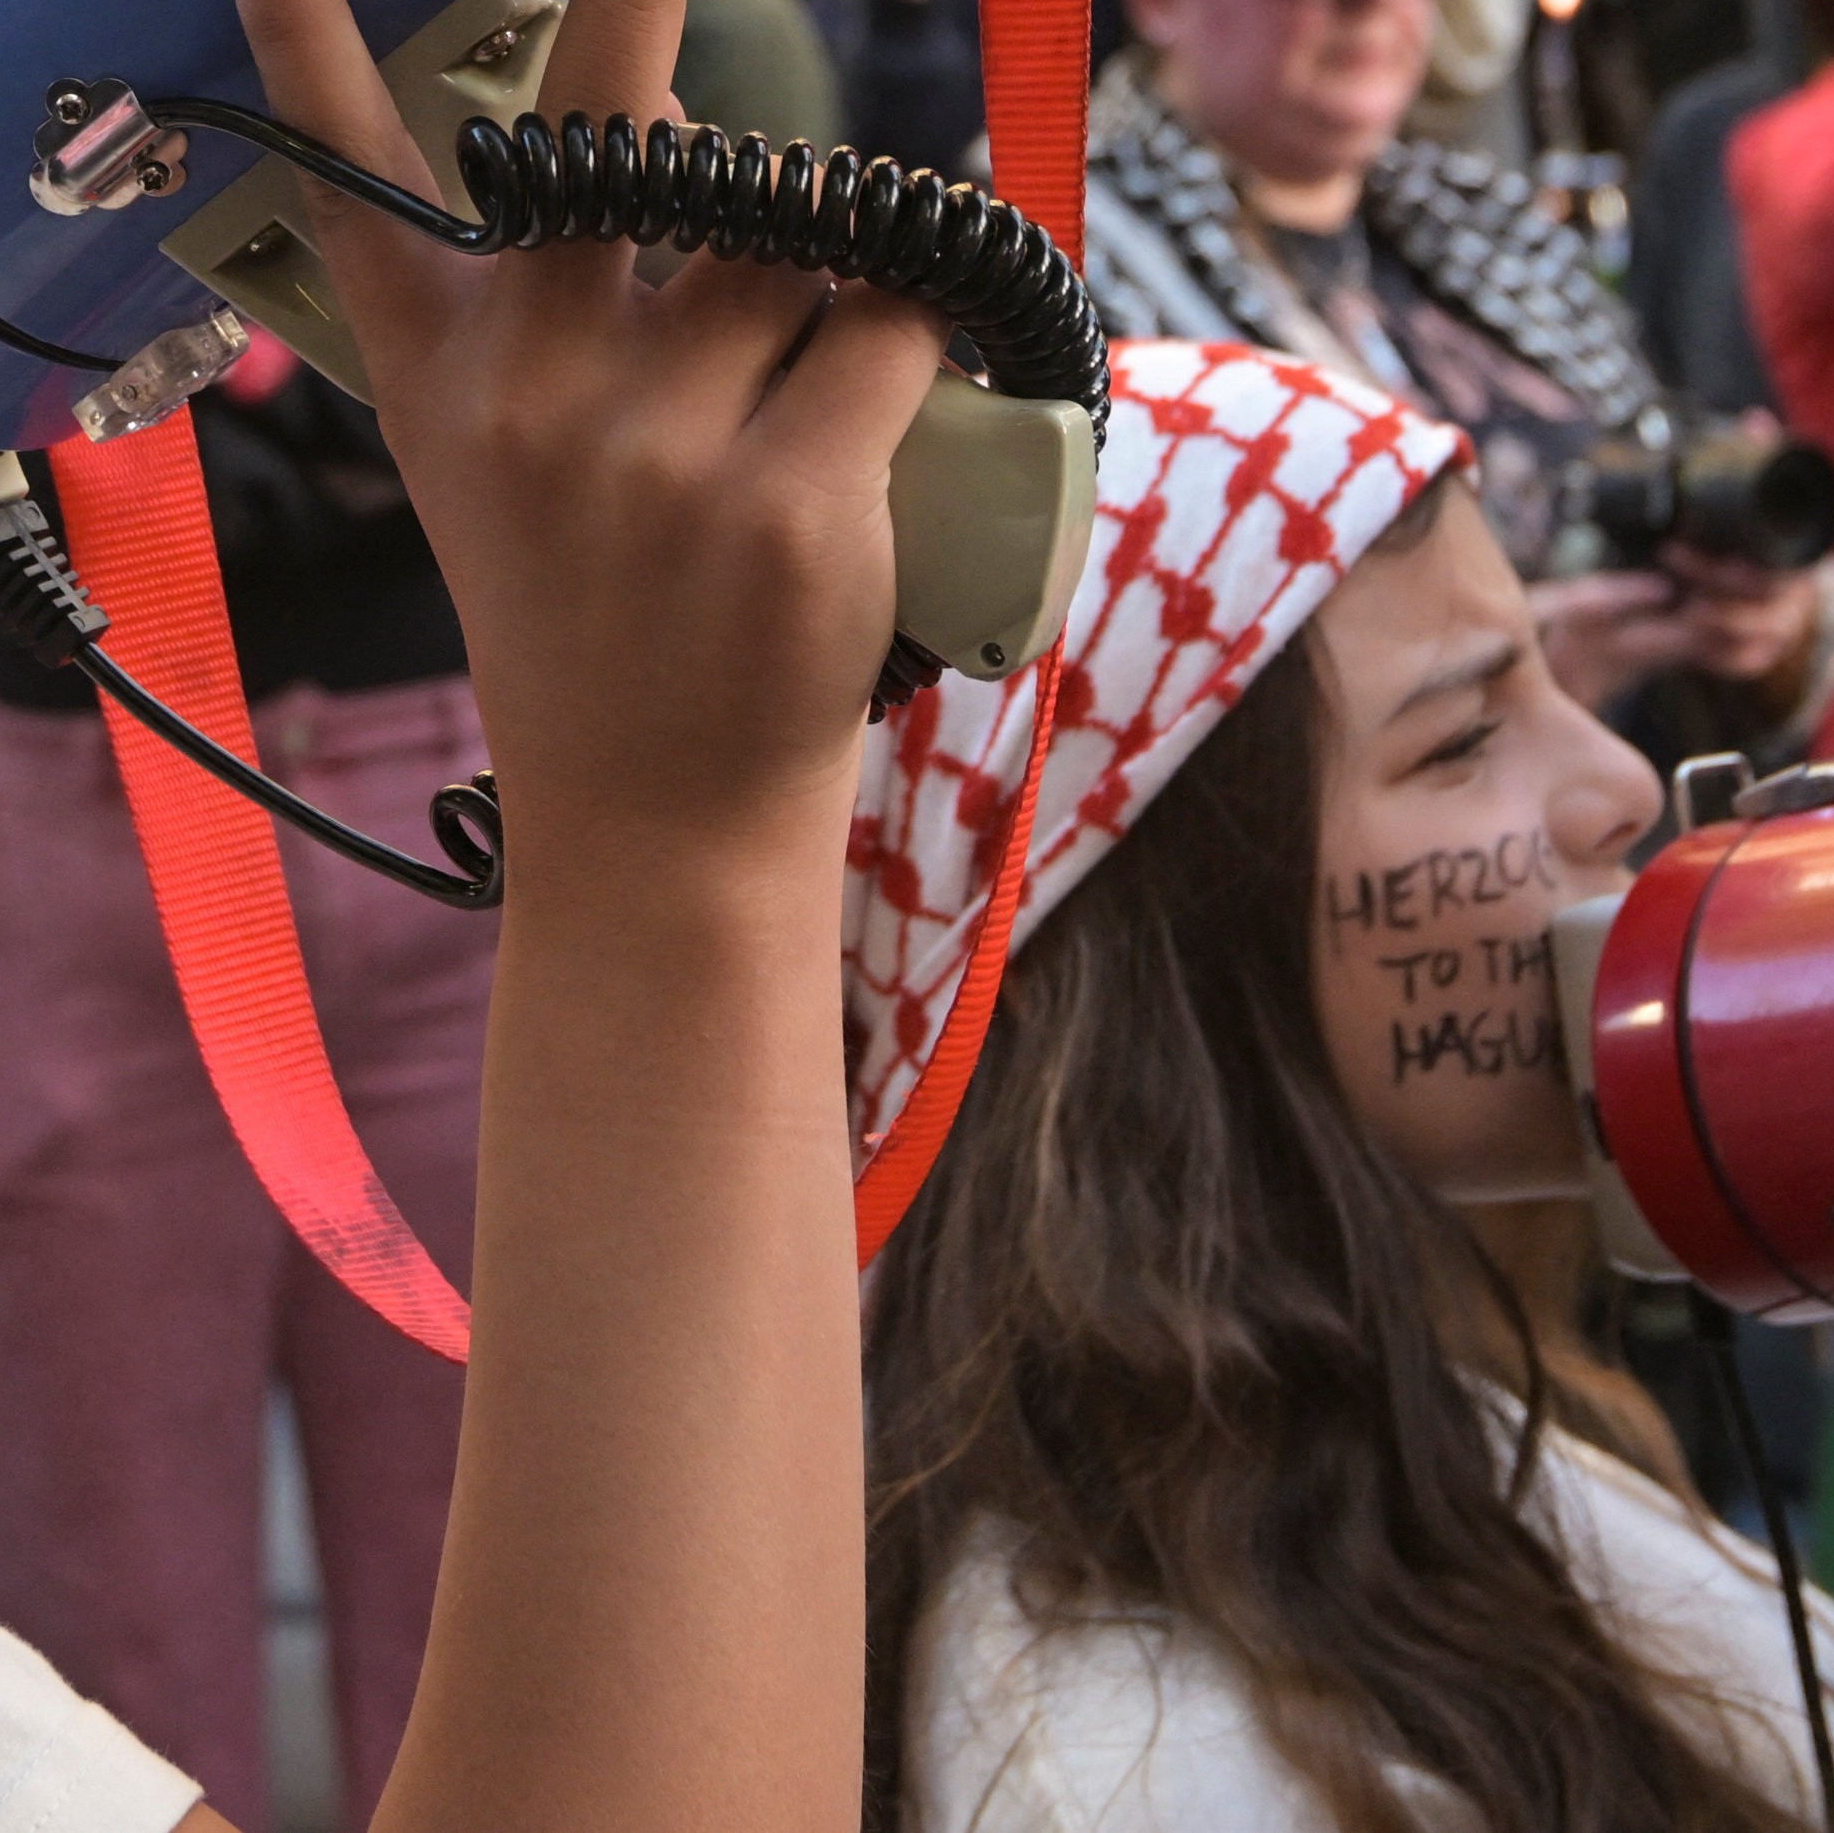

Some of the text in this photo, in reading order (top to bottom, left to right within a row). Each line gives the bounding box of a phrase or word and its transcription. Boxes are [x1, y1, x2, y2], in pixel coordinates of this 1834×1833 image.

[1378, 929, 1555, 1004] TO TH
[1392, 1012, 1552, 1086] HAGU
